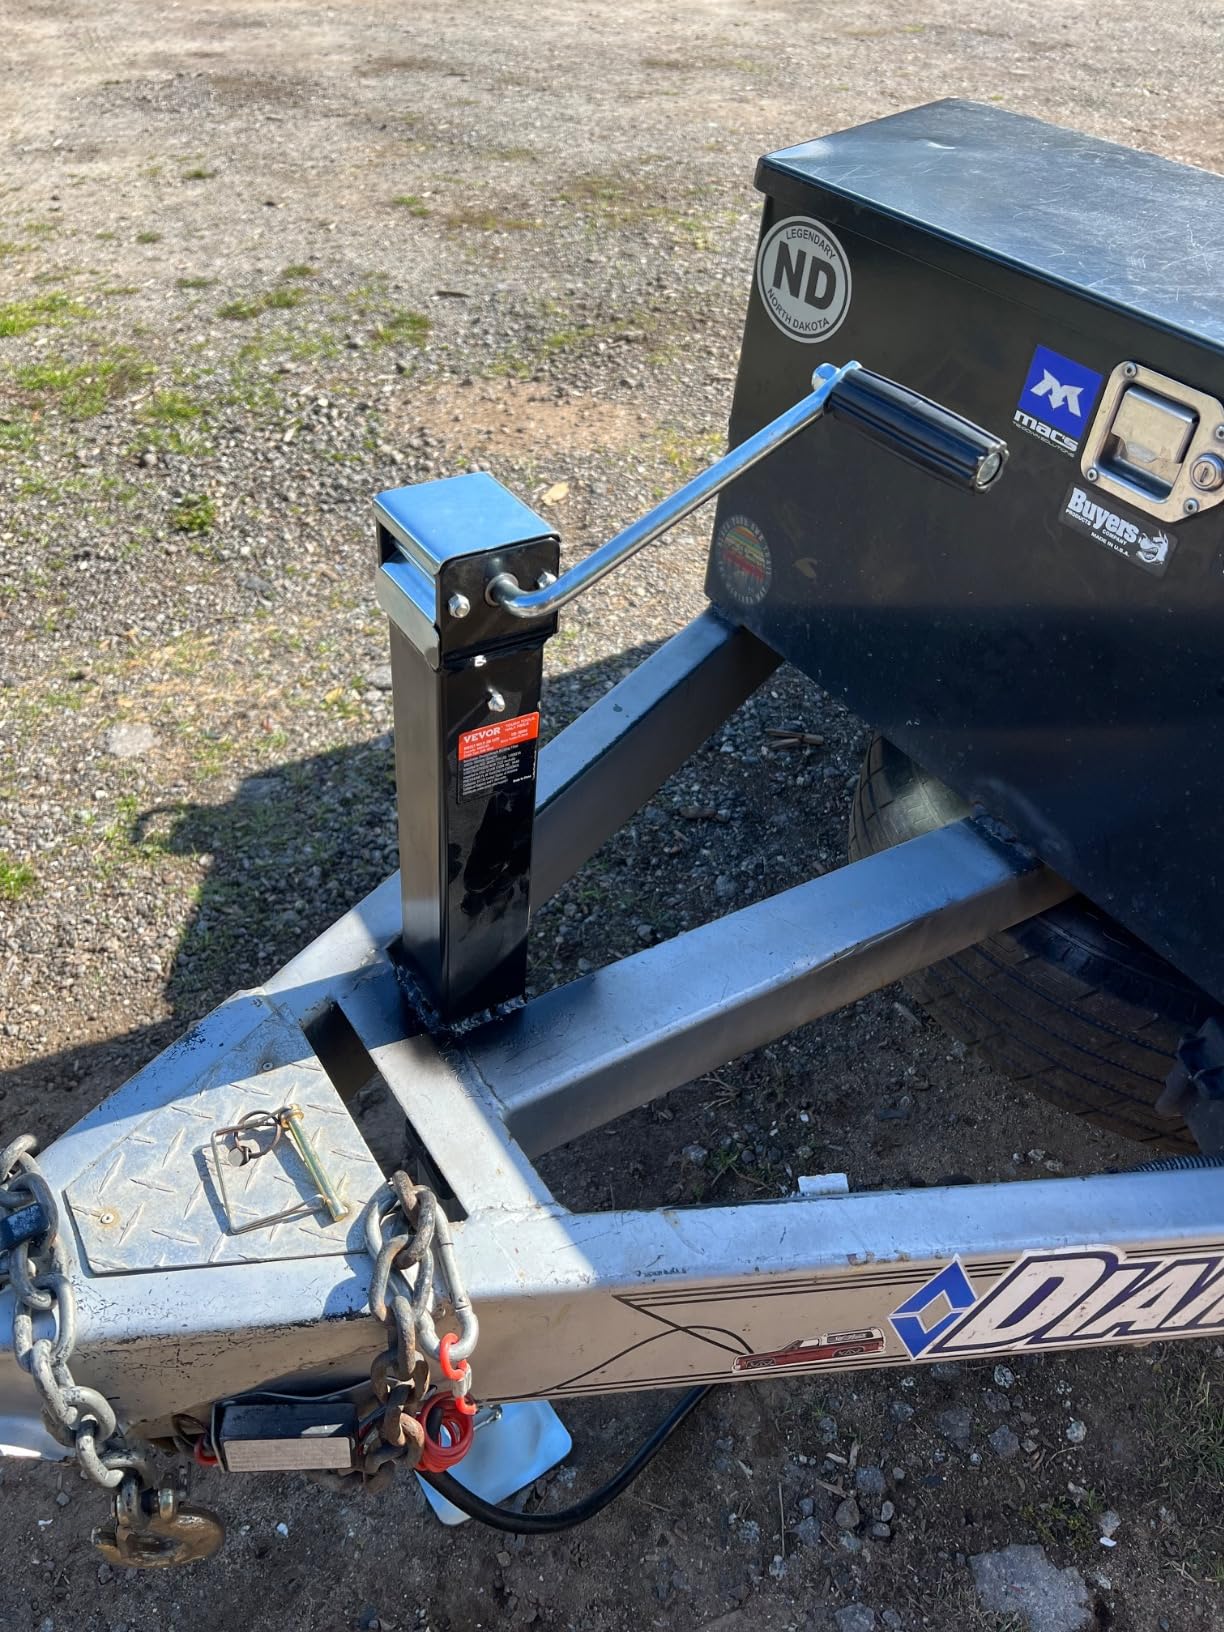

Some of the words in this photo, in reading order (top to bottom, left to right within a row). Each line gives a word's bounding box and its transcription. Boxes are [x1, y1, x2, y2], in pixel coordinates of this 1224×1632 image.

[785, 228, 836, 260] LEGENDARY
[772, 240, 837, 310] ND
[767, 288, 792, 325] NORTH
[792, 317, 830, 332] DAKOTA
[1065, 508, 1092, 526] PRODUCTS
[1102, 528, 1128, 546] COMPANY
[1067, 487, 1140, 543] Buyers
[1091, 531, 1107, 544] MADE
[463, 726, 501, 743] VEVOR
